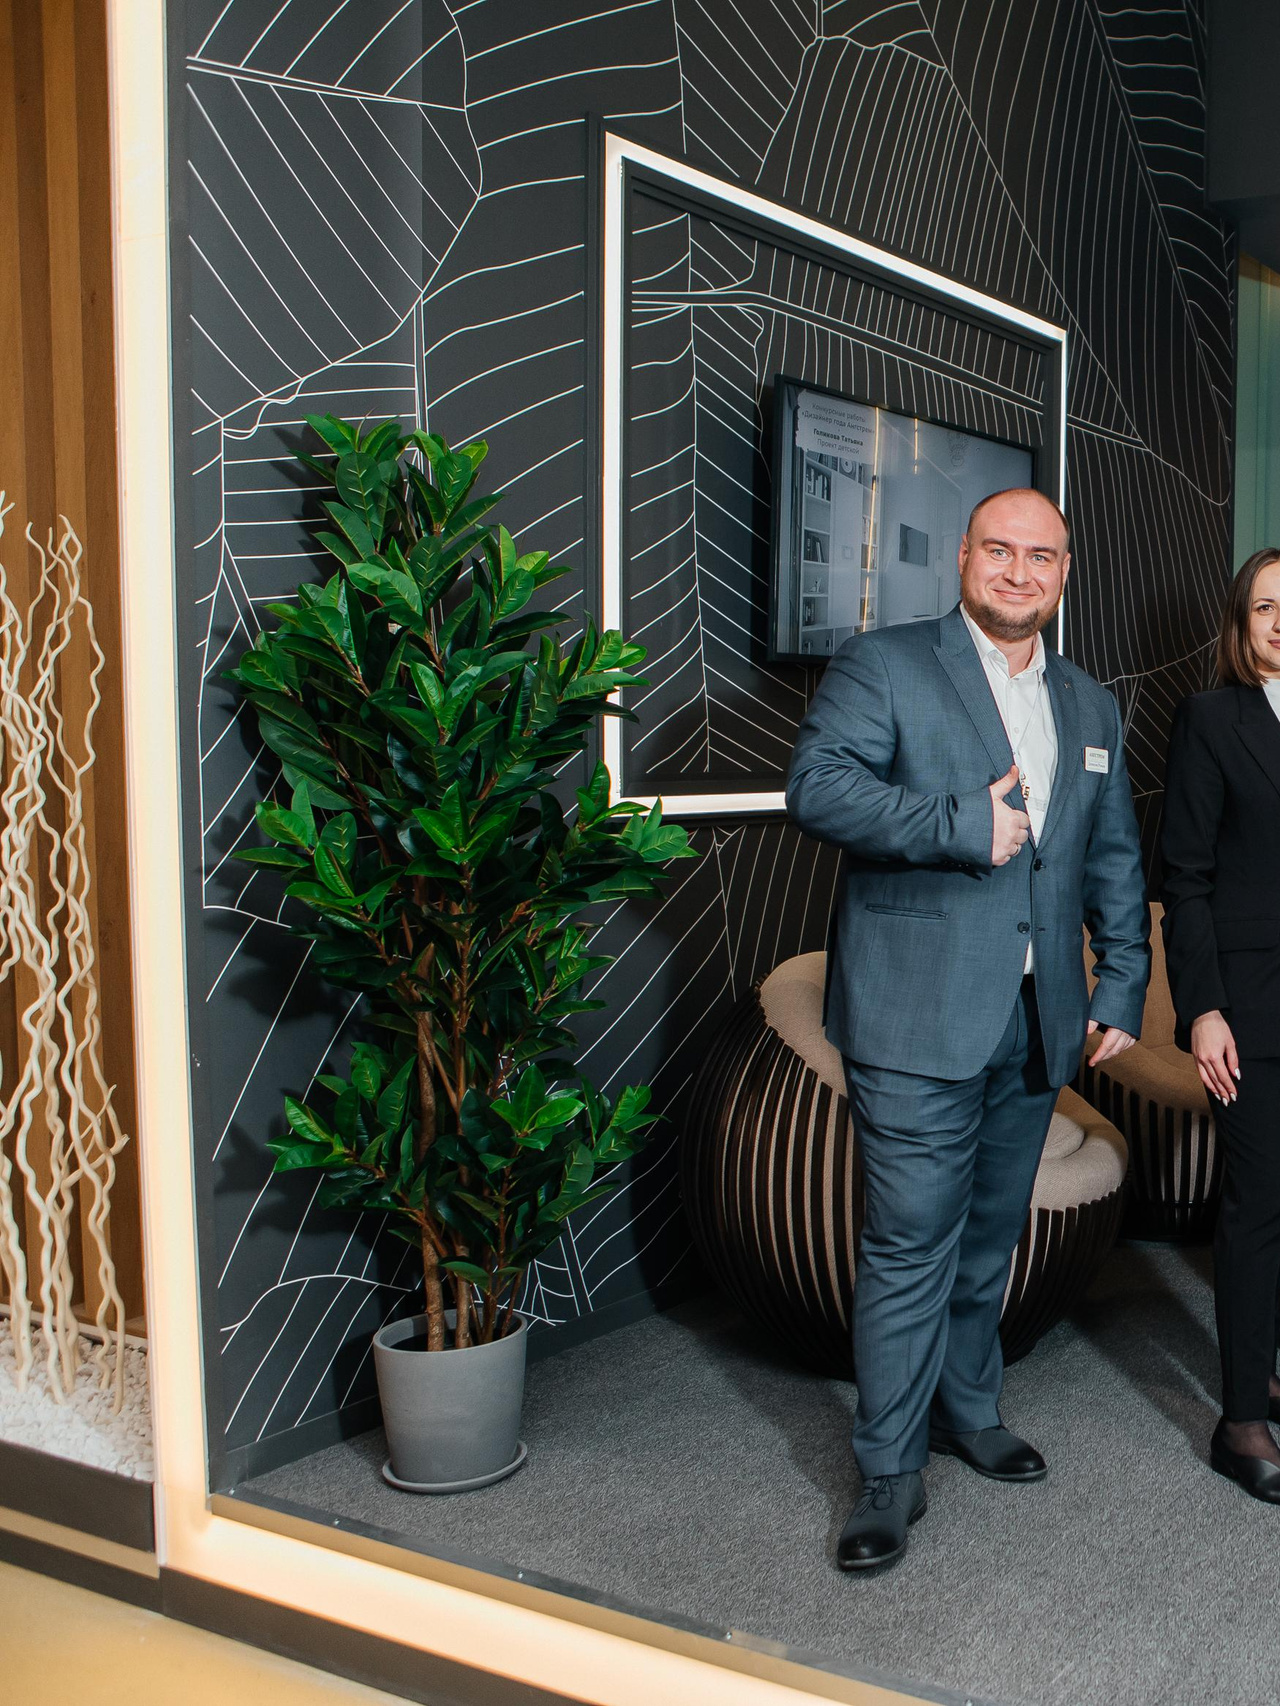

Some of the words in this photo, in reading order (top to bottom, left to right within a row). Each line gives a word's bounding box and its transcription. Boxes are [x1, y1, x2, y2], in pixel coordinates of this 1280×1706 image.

[813, 428, 840, 440] Голикова
[841, 435, 864, 446] Татьяна
[817, 439, 837, 449] Проект
[838, 445, 860, 454] детской
